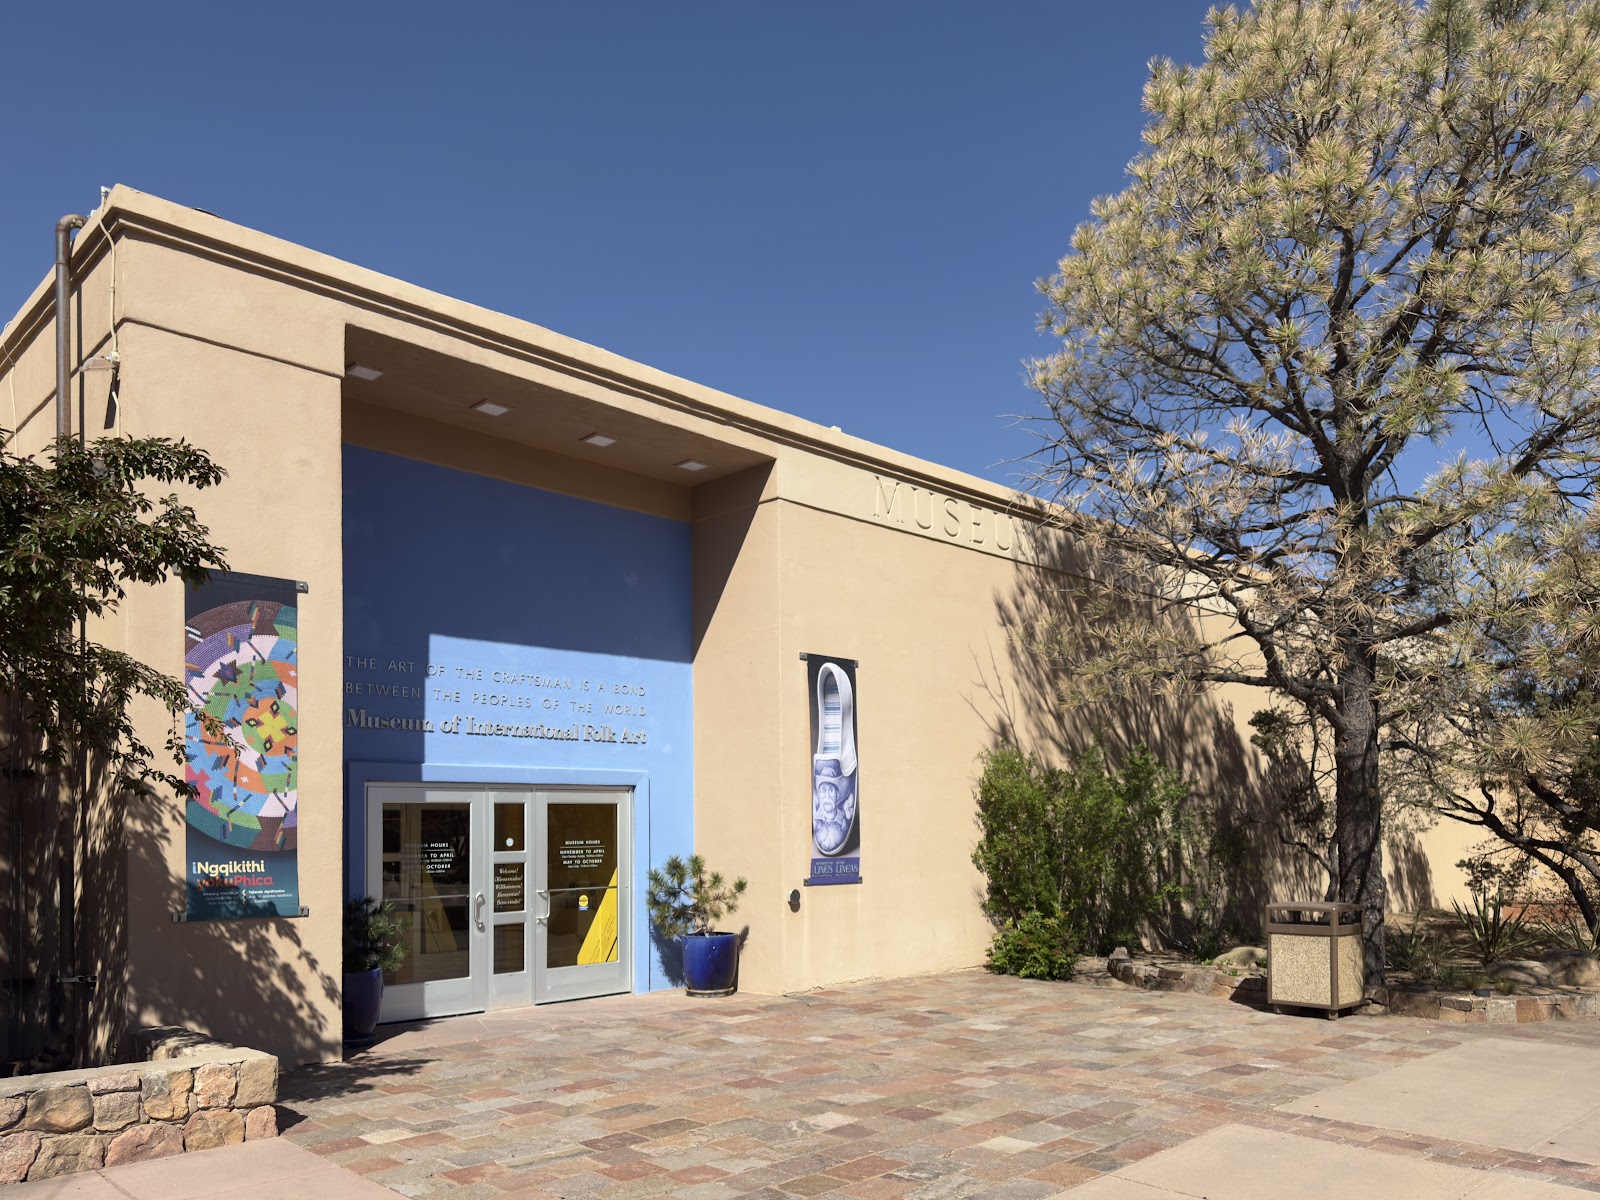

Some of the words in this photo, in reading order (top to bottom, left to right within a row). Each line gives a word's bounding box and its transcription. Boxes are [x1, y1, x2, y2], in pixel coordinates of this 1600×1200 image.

[346, 656, 377, 670] THE
[388, 660, 415, 672] ART
[426, 664, 445, 677] OF
[456, 668, 482, 681] THE
[492, 671, 571, 690] CRAFTSMAN
[579, 680, 590, 692] IS
[597, 683, 606, 693] A
[614, 684, 647, 697] BOND
[345, 682, 420, 699] BETWEEN
[433, 689, 461, 703] THE
[472, 693, 532, 709] PEOPLES
[542, 698, 559, 711] OF
[569, 701, 593, 714] THE
[603, 704, 647, 717] WORLD
[347, 708, 435, 734] Museum
[440, 715, 462, 735] of
[465, 716, 580, 742] International
[582, 724, 618, 744] Folk
[620, 727, 647, 745] Art
[192, 860, 265, 876] iNgqikithi
[197, 874, 273, 891] yokuPhica
